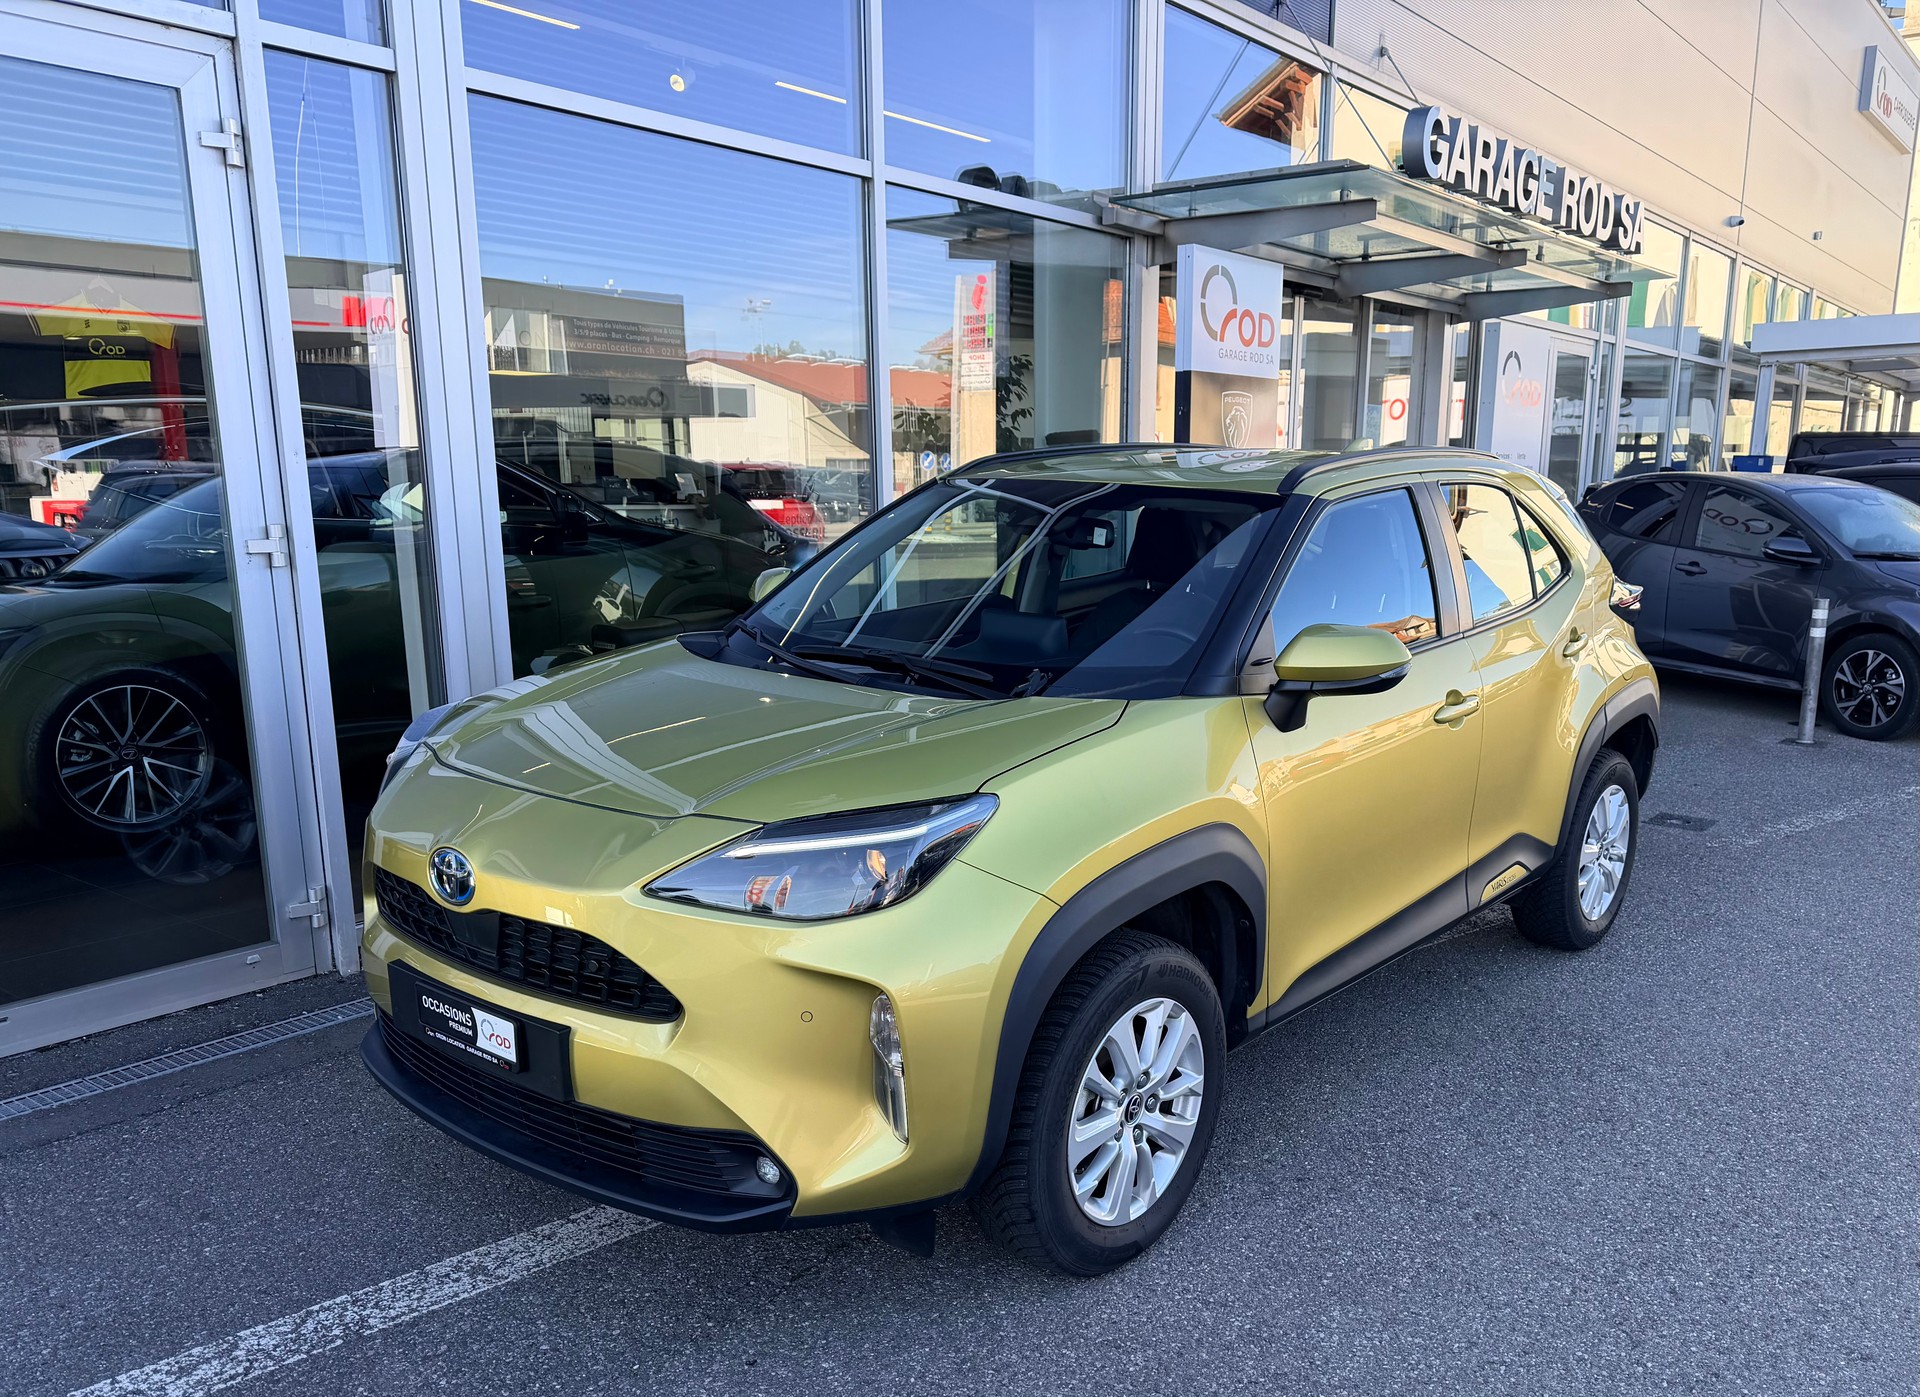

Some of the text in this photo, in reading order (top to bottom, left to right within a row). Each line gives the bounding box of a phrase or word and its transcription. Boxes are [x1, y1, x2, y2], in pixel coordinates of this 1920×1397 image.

[1418, 104, 1645, 254] GARAGE ROD SA
[573, 318, 587, 327] Tous
[588, 320, 603, 329] types
[590, 330, 608, 338] places
[625, 333, 650, 343] Camping
[1218, 348, 1274, 365] GARAGE ROD SA
[1224, 396, 1250, 405] PEUGEOT
[422, 995, 472, 1027] OCCASIONS
[448, 1020, 473, 1037] PREMIUM
[446, 1036, 465, 1050] LOCATION
